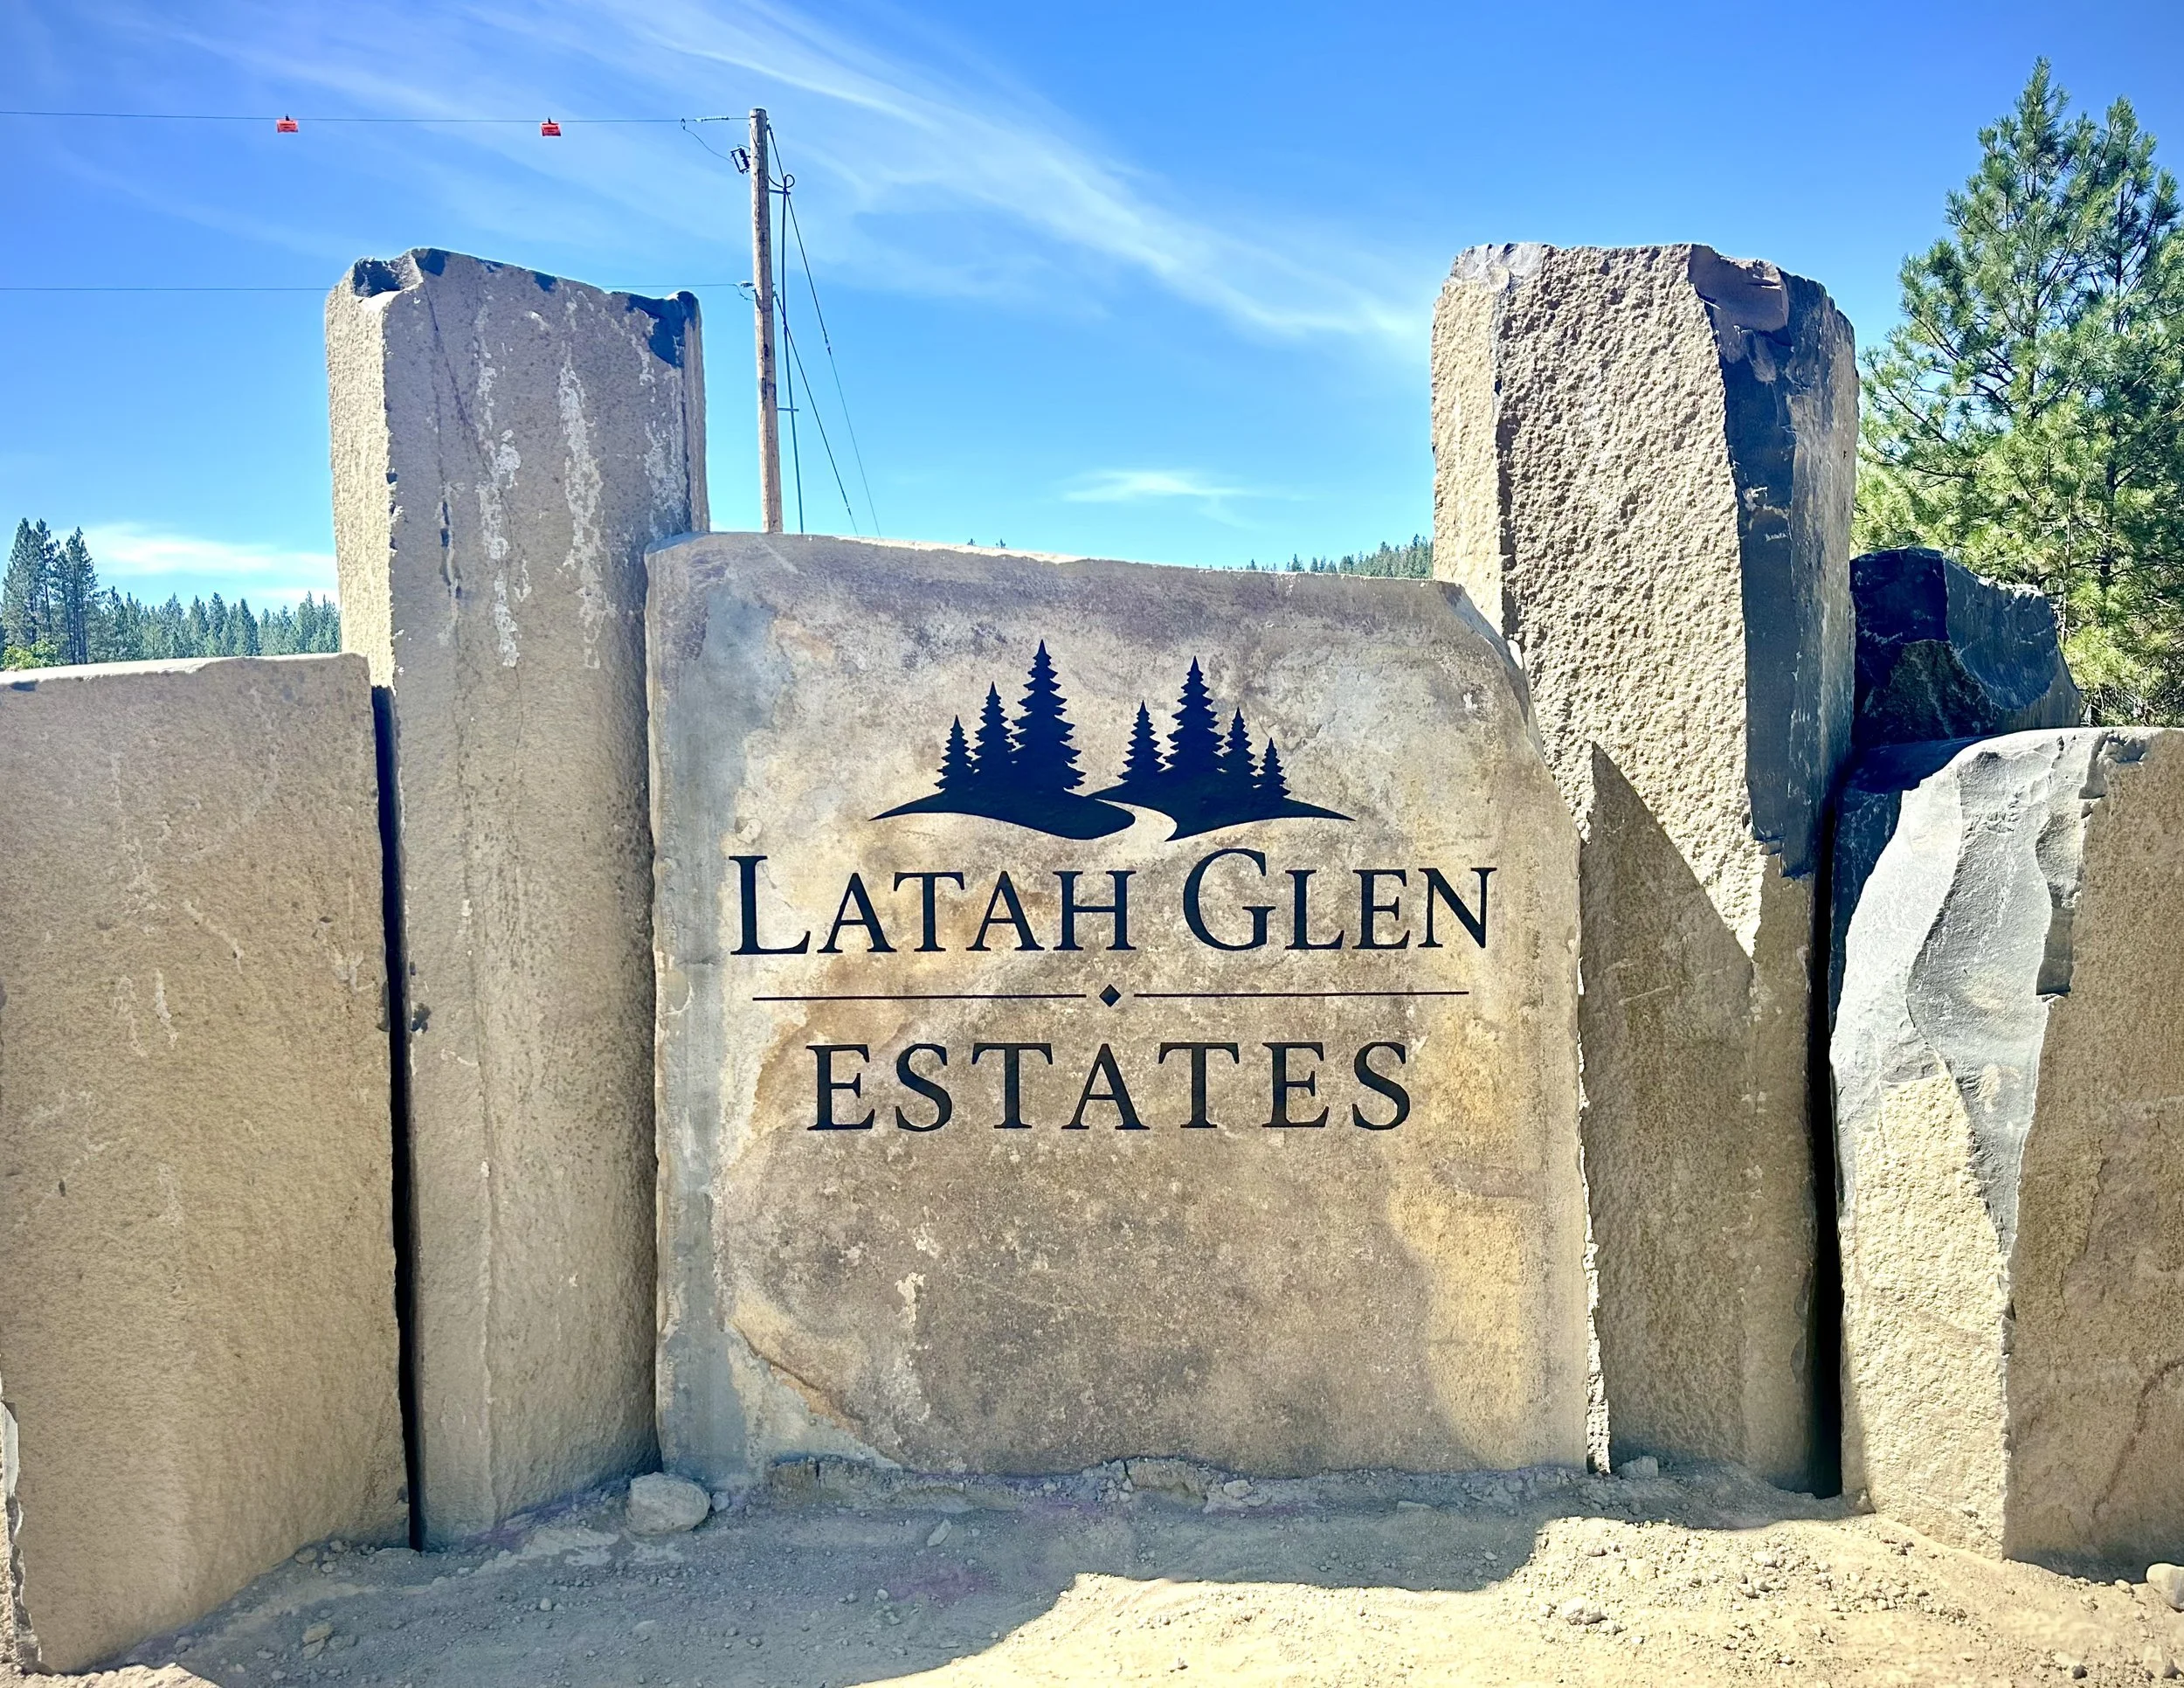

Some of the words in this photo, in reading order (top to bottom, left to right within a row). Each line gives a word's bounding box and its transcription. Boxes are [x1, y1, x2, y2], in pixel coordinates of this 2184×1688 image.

[729, 855, 1137, 956] LATAH
[1183, 847, 1497, 951] GLEN
[805, 1041, 1412, 1132] ESTATES
